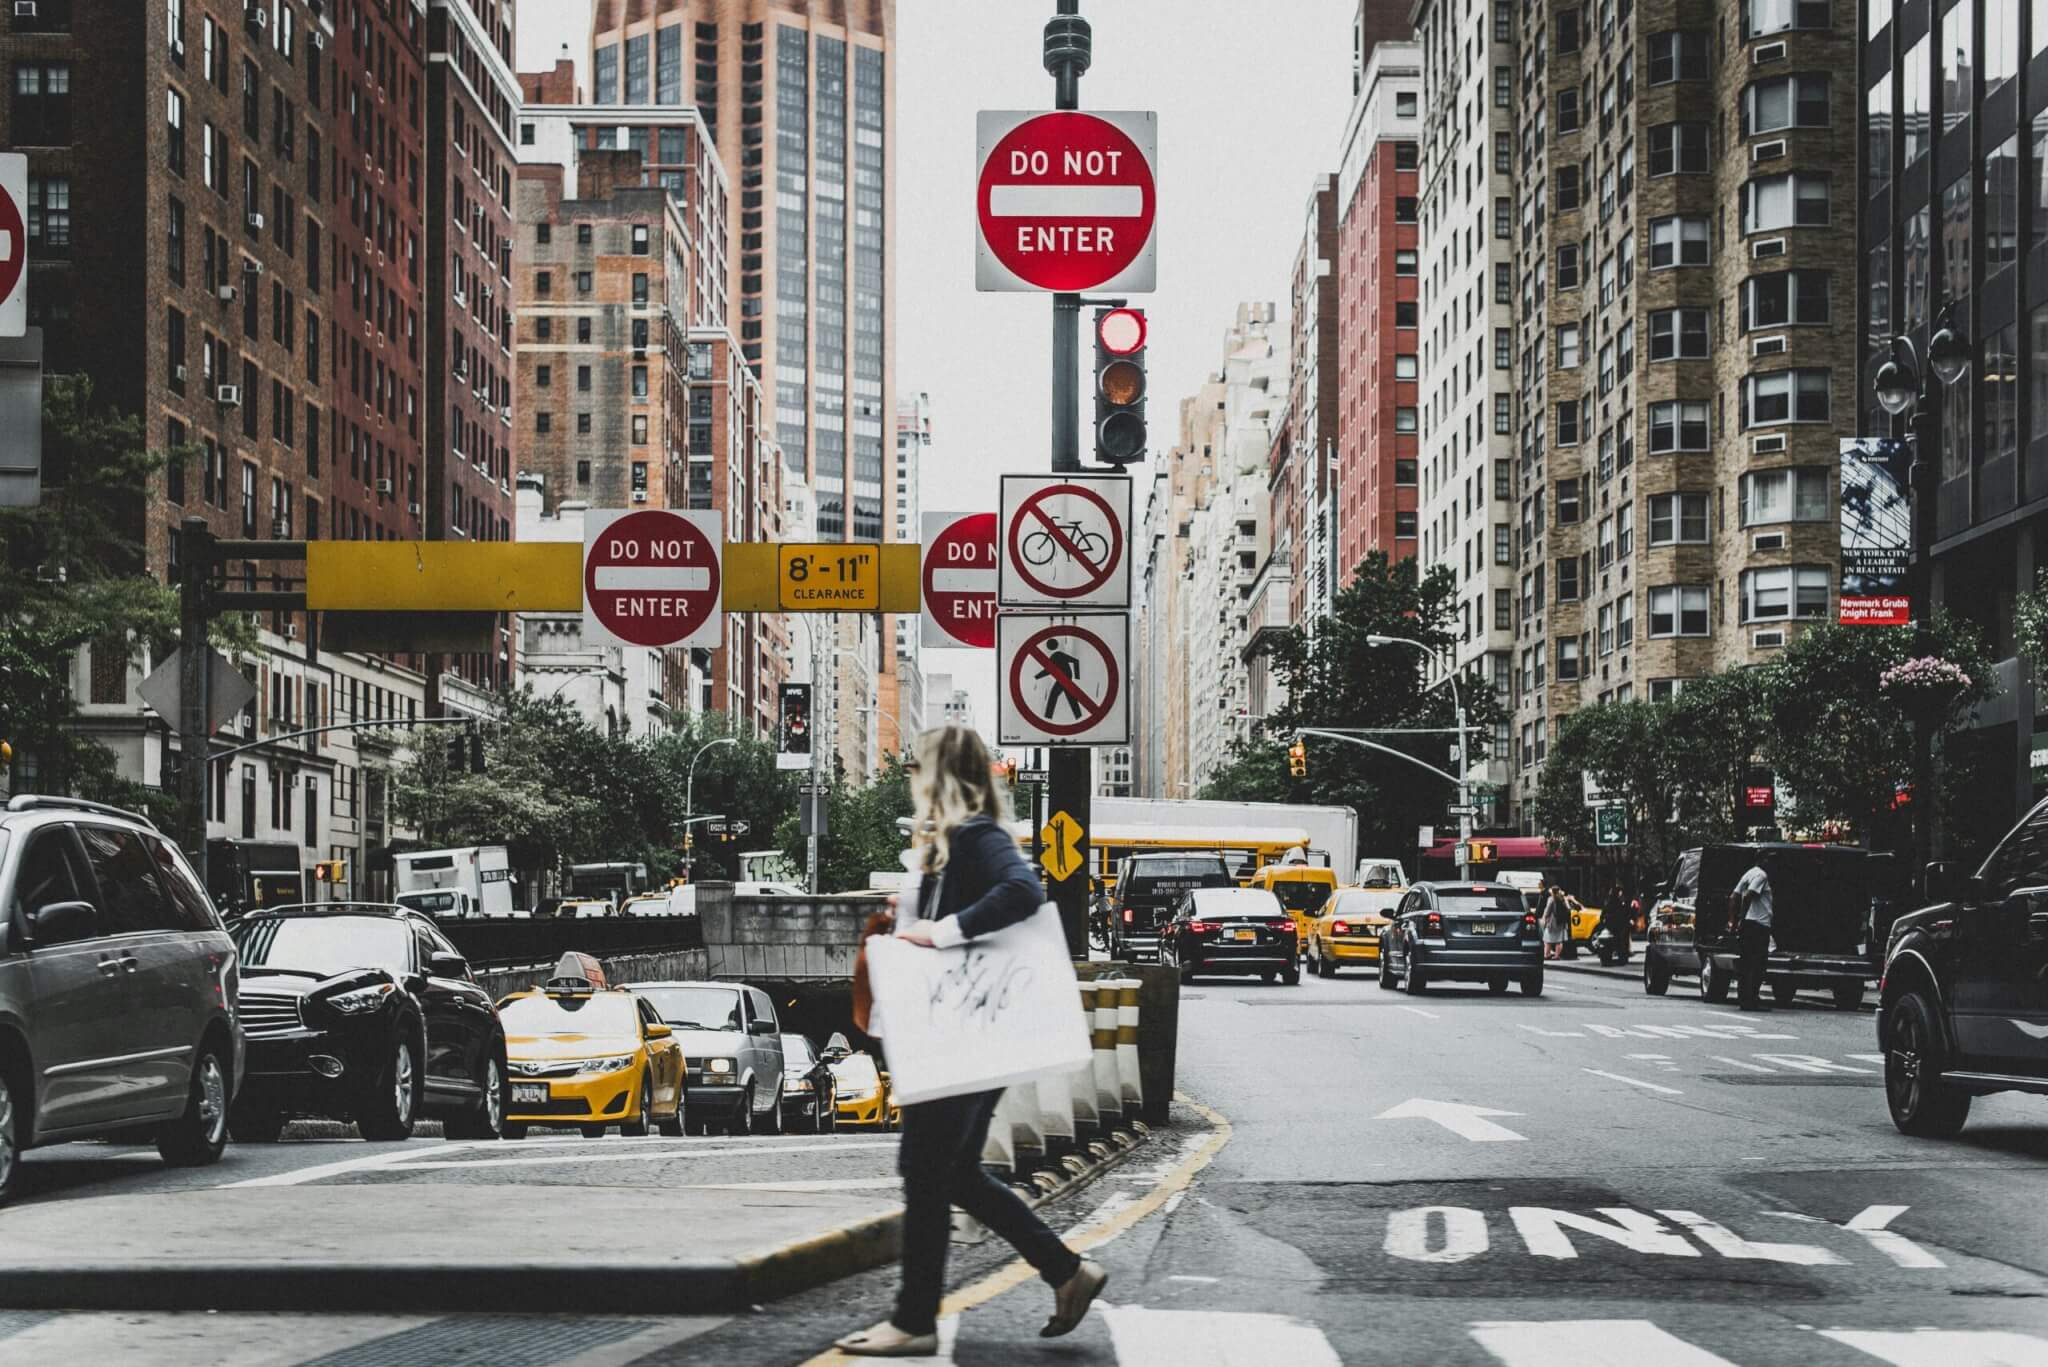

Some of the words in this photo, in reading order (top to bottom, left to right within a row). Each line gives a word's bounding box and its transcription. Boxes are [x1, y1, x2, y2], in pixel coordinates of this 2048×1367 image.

[1011, 151, 1049, 176] DO
[1064, 151, 1122, 176] NOT
[1018, 226, 1115, 252] ENTER
[610, 540, 639, 559] DO
[650, 540, 695, 560] NOT
[948, 542, 977, 561] DO
[1863, 558, 1895, 566] LEADER
[793, 589, 865, 600] CLEARANCE
[1840, 599, 1880, 608] Newmark
[1882, 599, 1909, 608] Grubb
[615, 598, 689, 617] ENTER
[953, 600, 996, 619] ENT
[1840, 608, 1868, 619] Knight
[1870, 609, 1894, 618] Frank
[1515, 1024, 1800, 1040] LANE
[1383, 1205, 1948, 1269] ONLY
